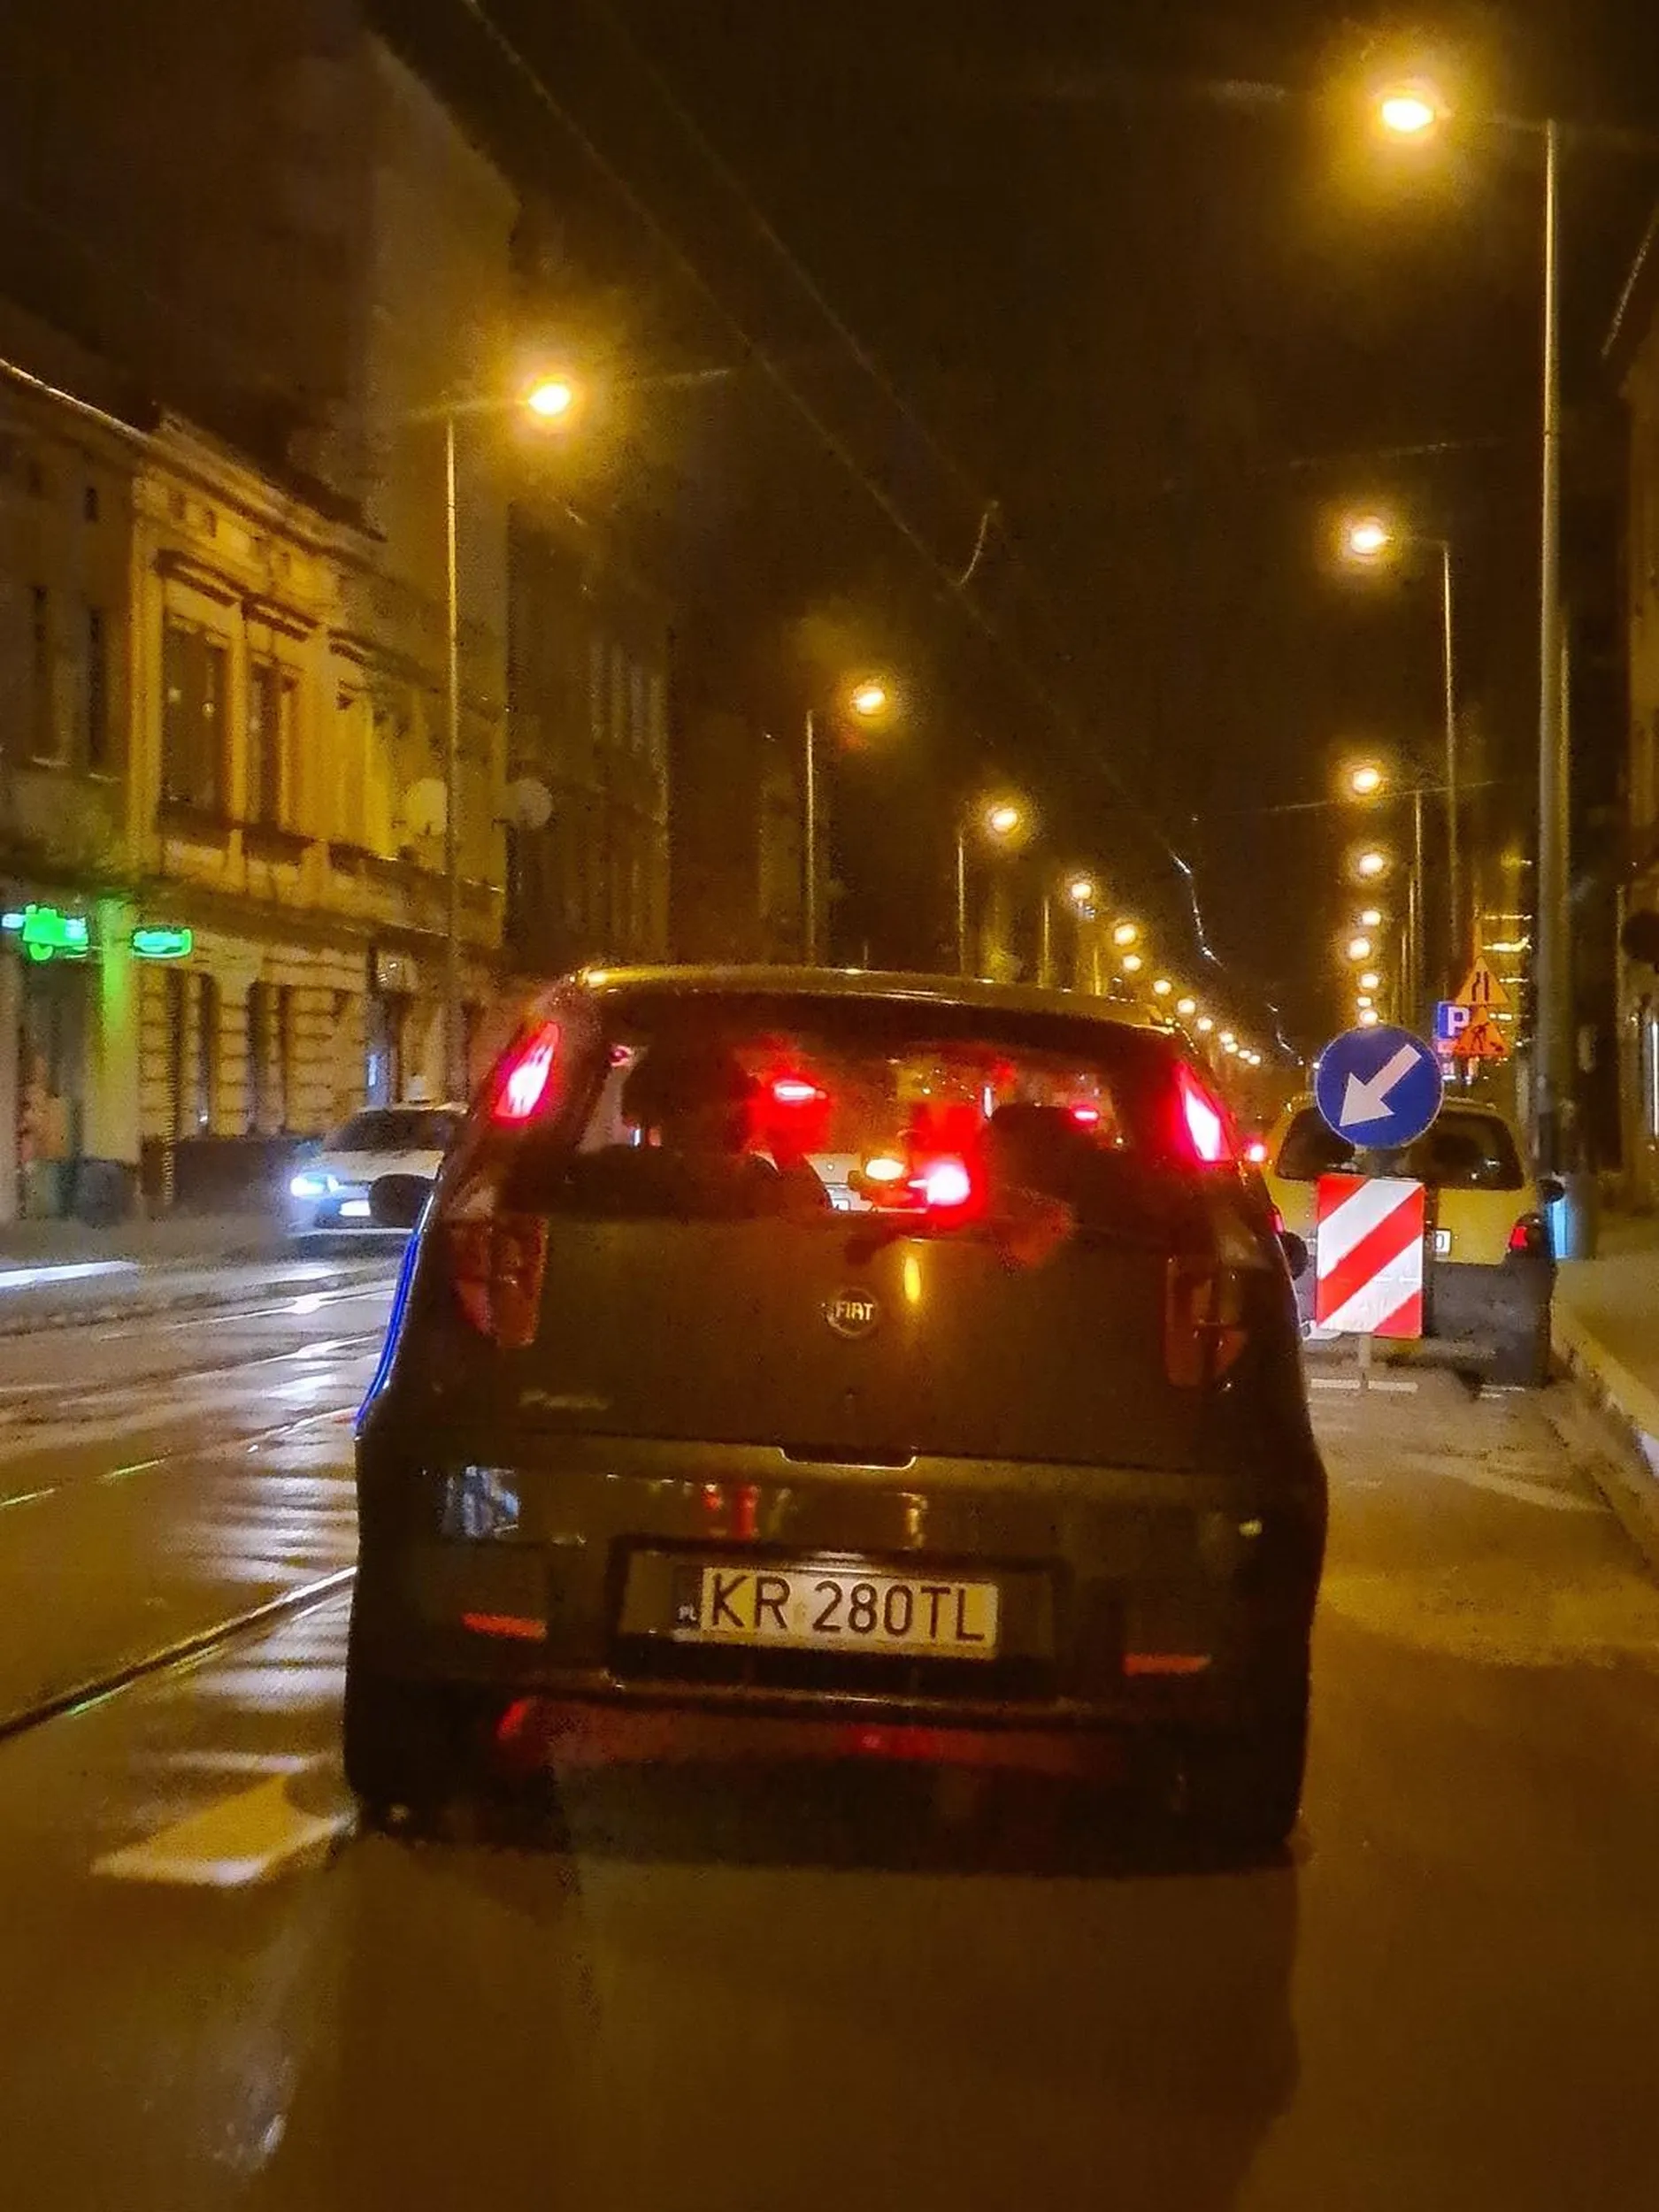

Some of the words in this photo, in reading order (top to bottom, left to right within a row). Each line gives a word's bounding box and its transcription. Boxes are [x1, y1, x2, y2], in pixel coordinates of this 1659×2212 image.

[1448, 1006, 1471, 1037] P
[835, 1301, 874, 1321] FIAT
[710, 1573, 792, 1630] KR
[811, 1579, 986, 1642] 280TL
